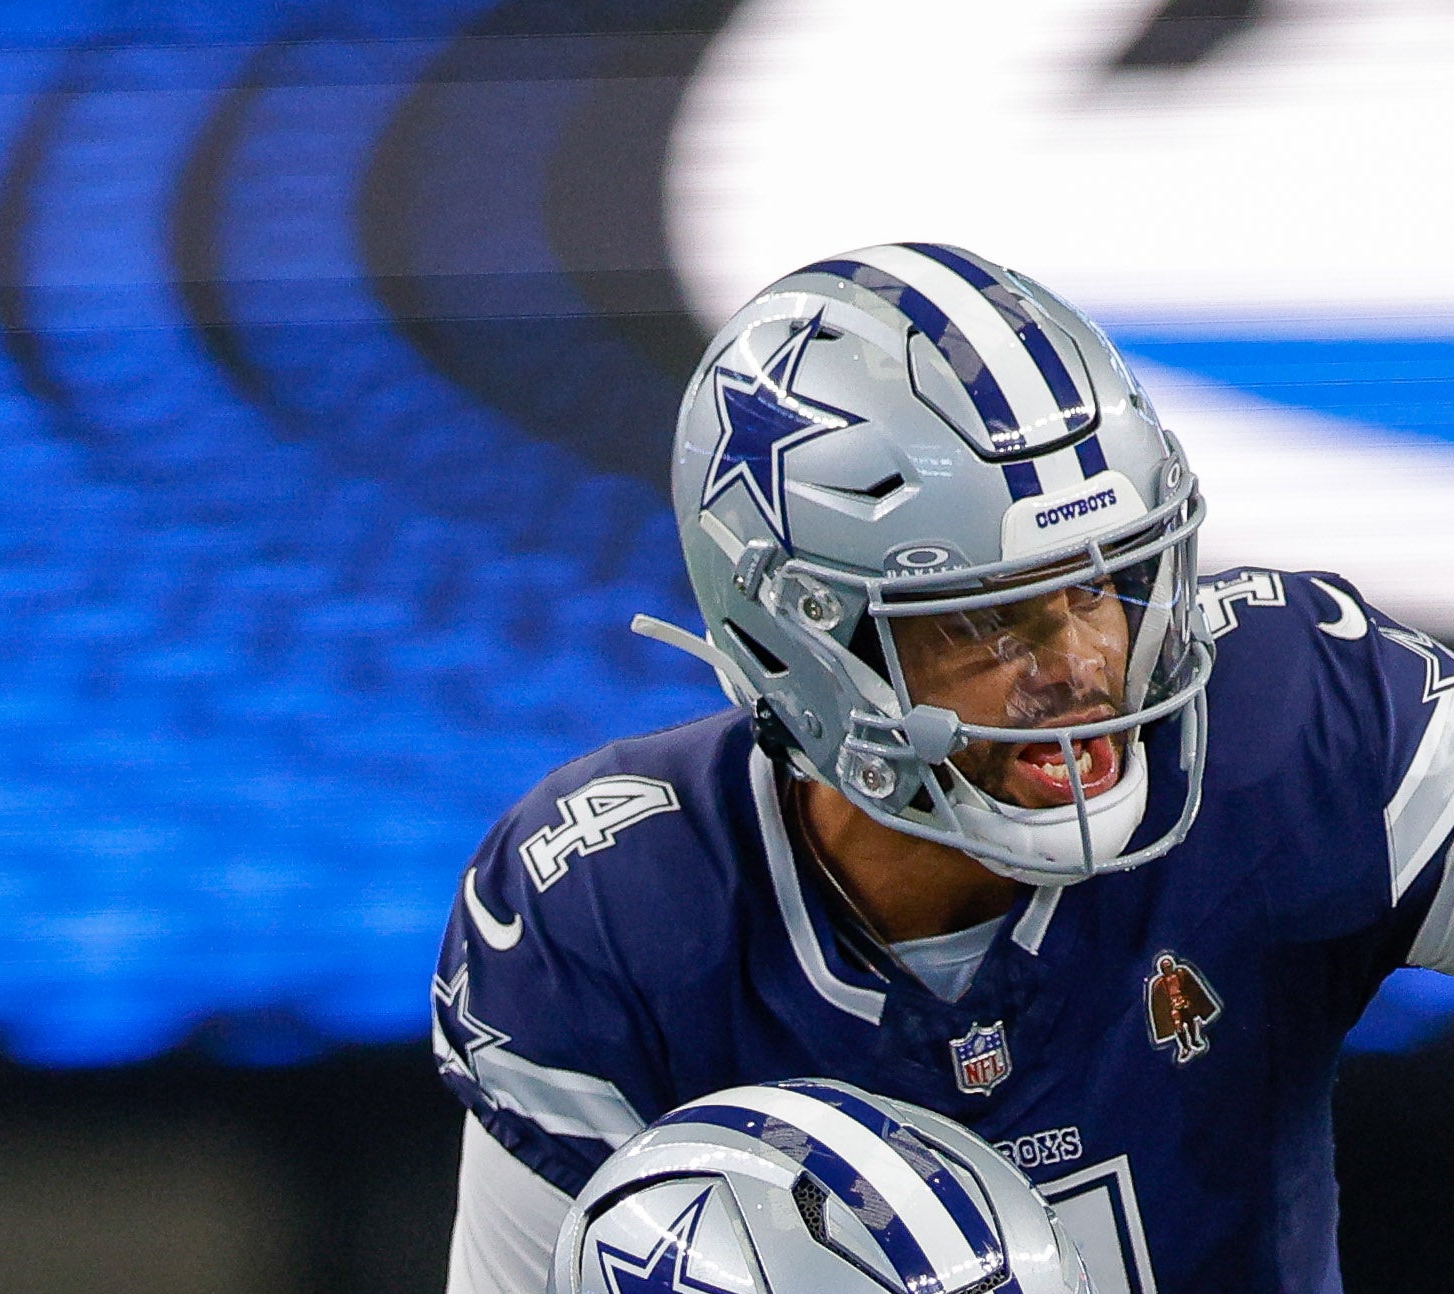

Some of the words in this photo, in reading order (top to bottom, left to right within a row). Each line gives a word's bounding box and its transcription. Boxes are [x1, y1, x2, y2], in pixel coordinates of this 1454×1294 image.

[1035, 488, 1117, 529] COWBOYS
[518, 774, 681, 893] 4
[965, 1055, 1004, 1085] NFL
